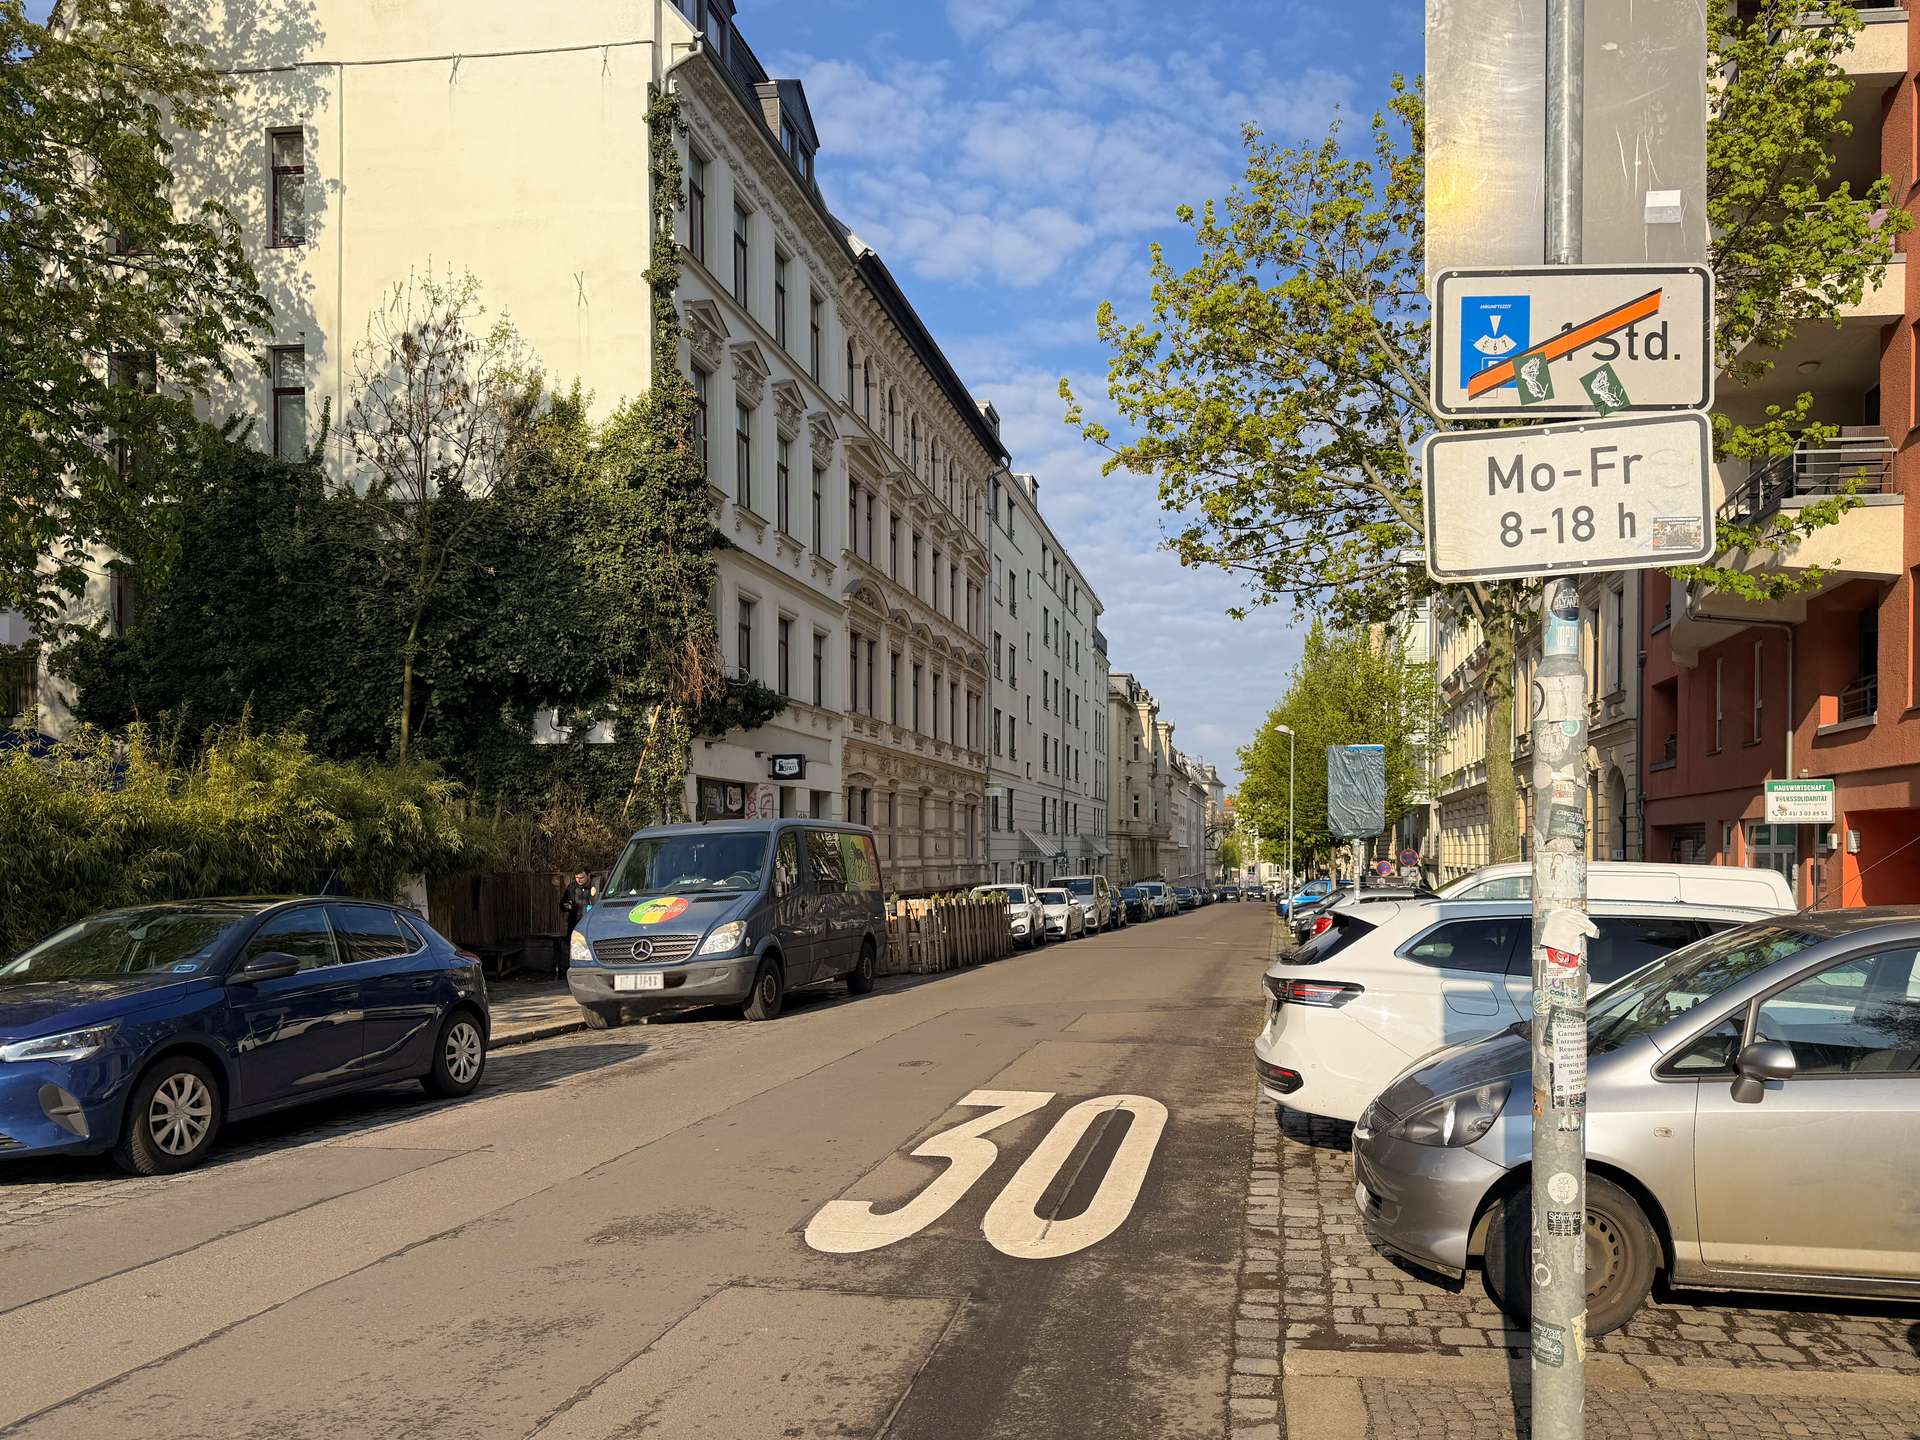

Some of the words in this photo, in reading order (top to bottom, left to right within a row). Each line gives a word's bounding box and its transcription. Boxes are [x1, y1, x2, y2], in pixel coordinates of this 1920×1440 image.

[1592, 320, 1681, 361] Std.
[1487, 445, 1643, 496] Mo-Fr
[1500, 505, 1595, 548] 8-18
[1618, 502, 1636, 539] h
[805, 1090, 1168, 1259] 30
